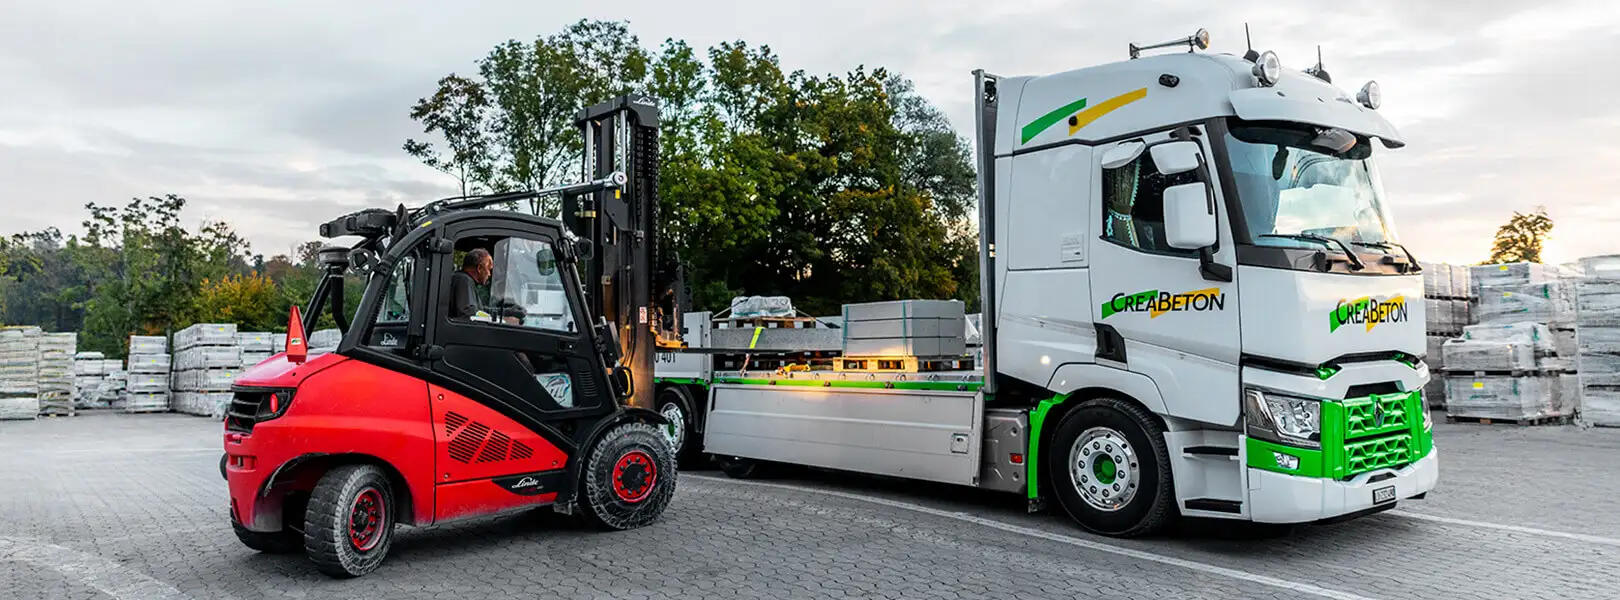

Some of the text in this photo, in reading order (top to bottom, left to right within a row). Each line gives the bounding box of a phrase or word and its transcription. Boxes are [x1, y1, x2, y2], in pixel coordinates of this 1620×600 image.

[1110, 292, 1225, 312] CREABETON
[1336, 298, 1408, 325] CREABETON
[511, 476, 539, 489] Linde
